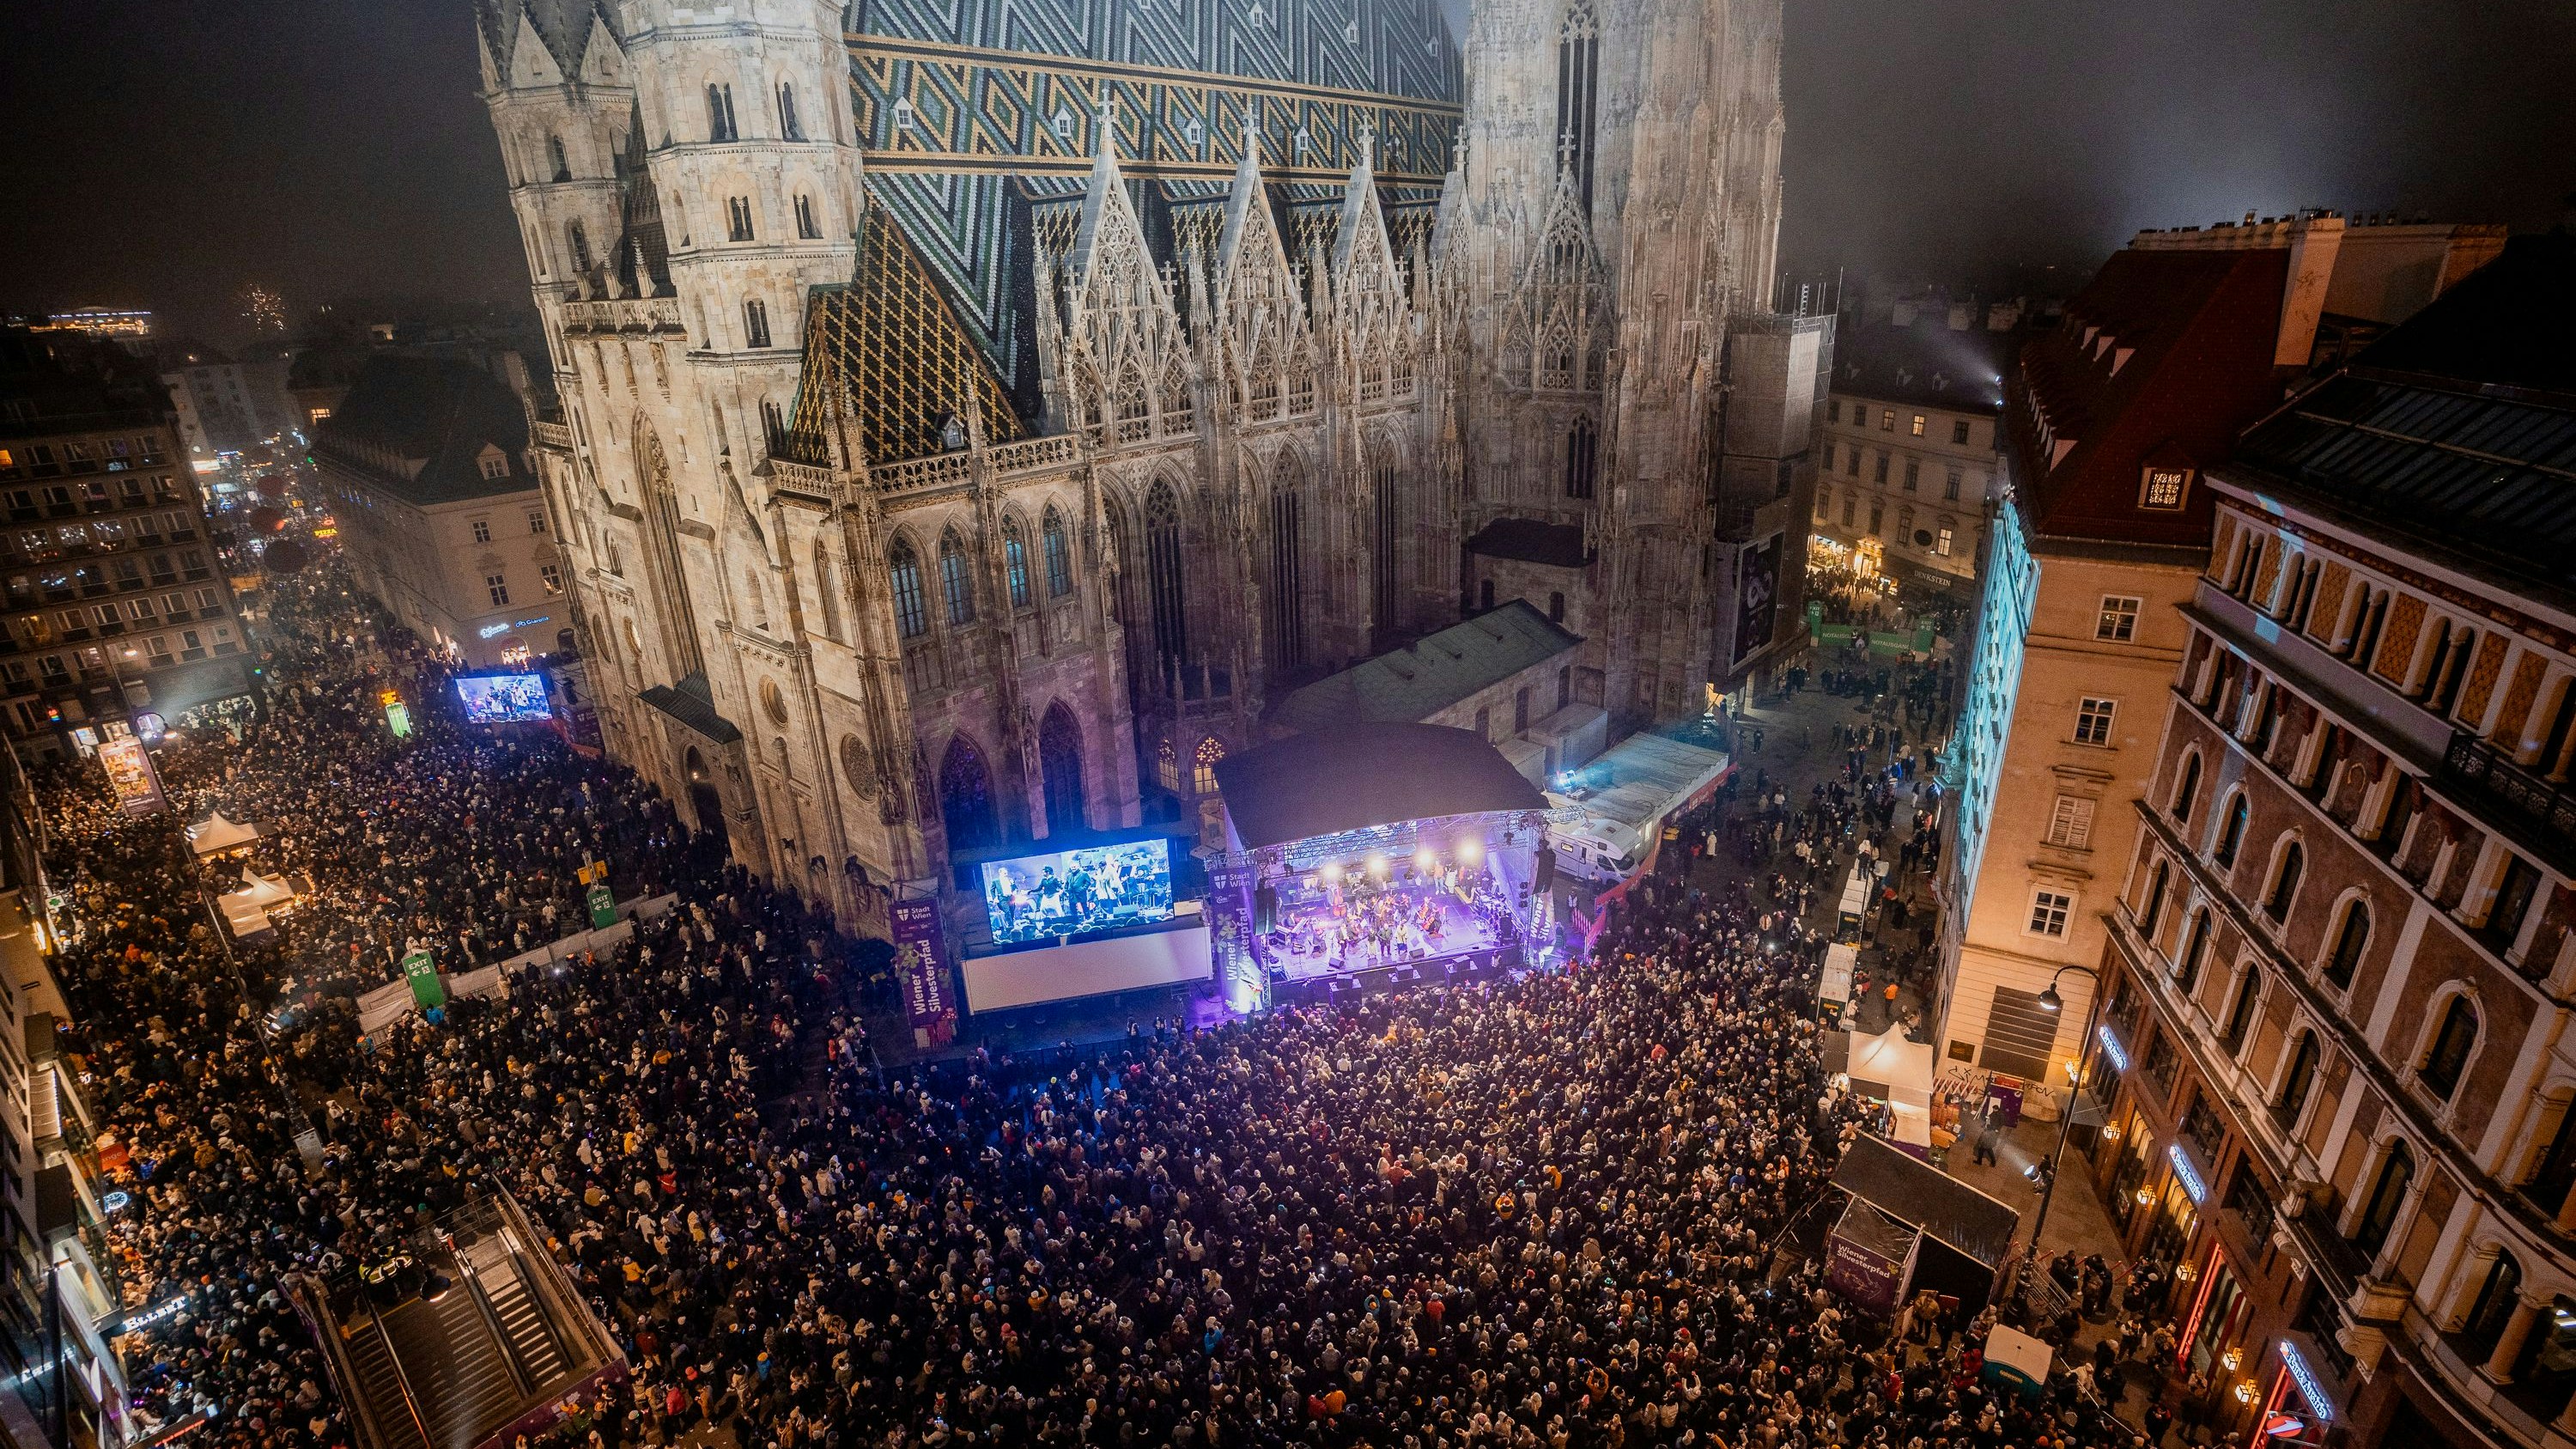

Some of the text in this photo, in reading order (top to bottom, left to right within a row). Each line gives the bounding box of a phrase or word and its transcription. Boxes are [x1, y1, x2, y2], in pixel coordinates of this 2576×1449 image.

[313, 527, 337, 538] PIZZA
[1914, 569, 1951, 587] DENKSTEIN
[1229, 873, 1250, 881] Stadt
[592, 894, 608, 904] EXIT
[911, 905, 931, 915] Stadt
[912, 912, 932, 921] Wien
[408, 959, 428, 971] EXIT
[1226, 941, 1238, 981] Wiener
[916, 939, 941, 1013] Silvesterpfad
[912, 974, 927, 1015] Wiener
[1838, 1243, 1868, 1262] Wiener
[1837, 1250, 1890, 1279] Silvesterpfad
[2287, 1352, 2328, 1420] Bank Austria
